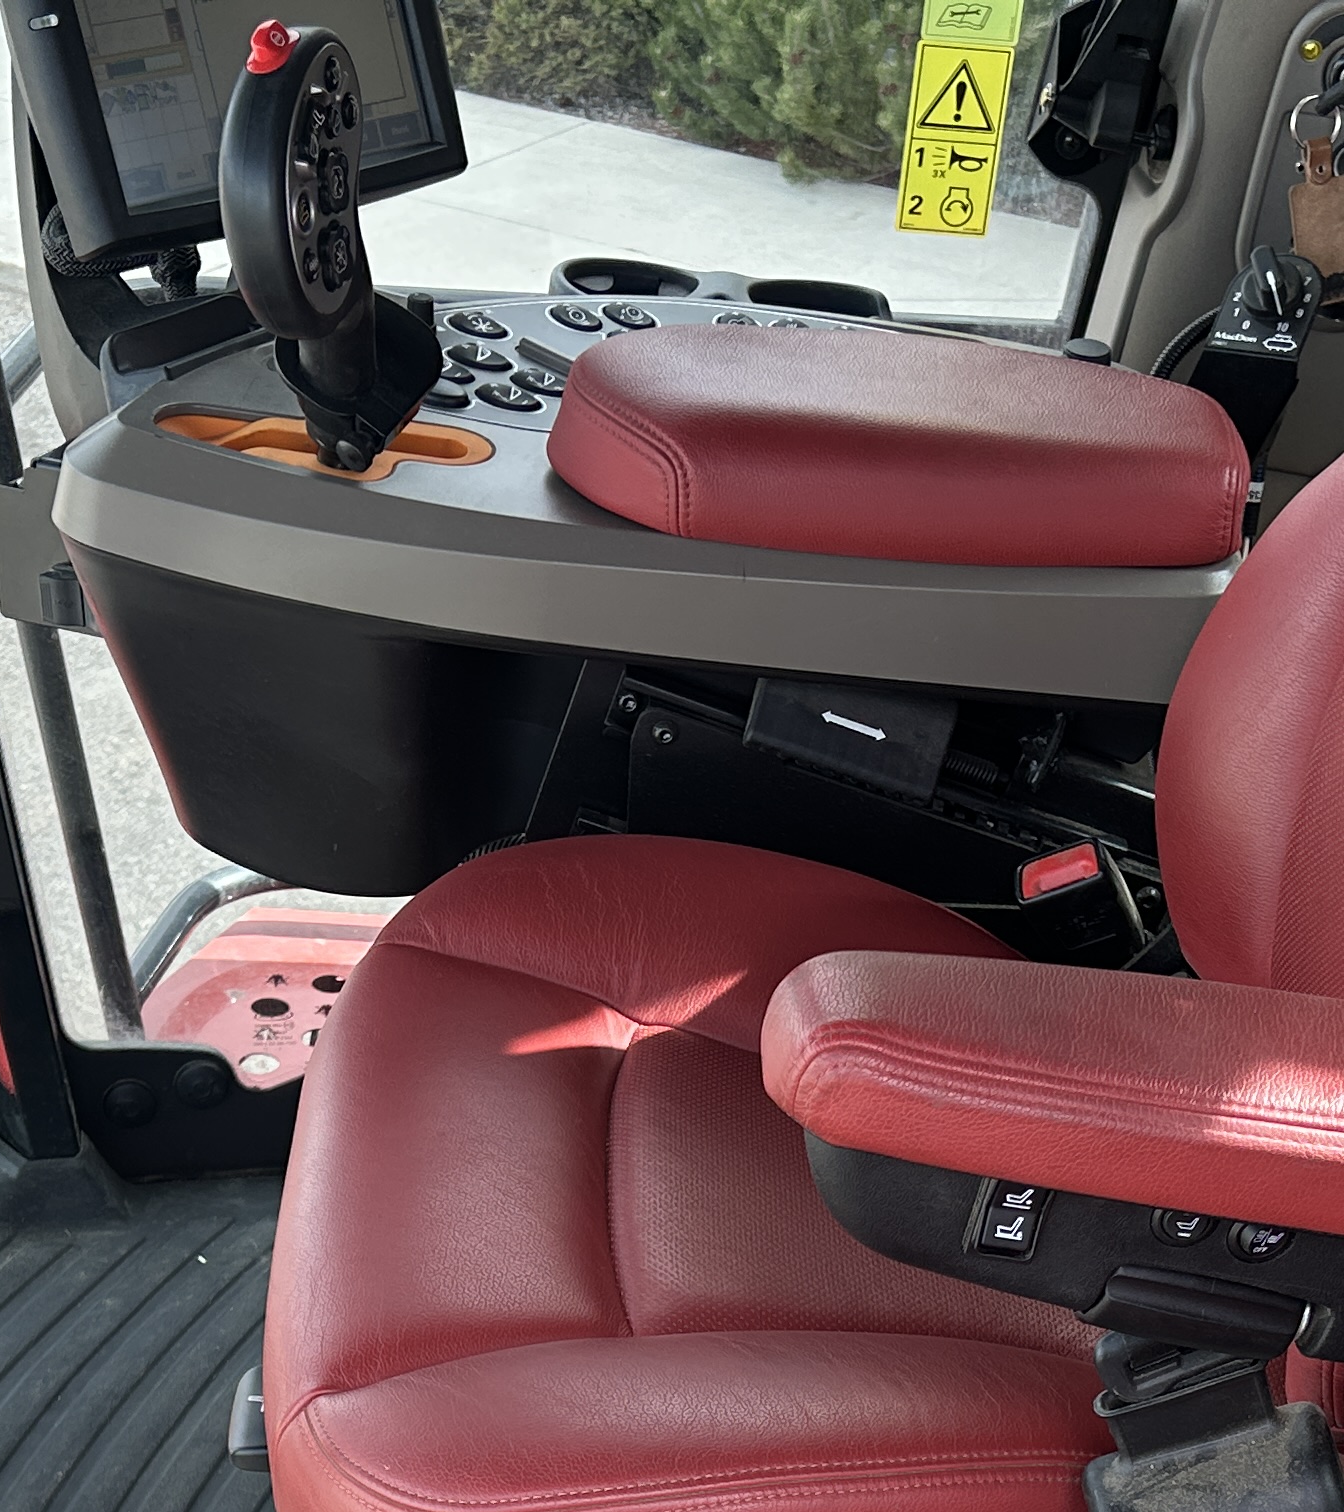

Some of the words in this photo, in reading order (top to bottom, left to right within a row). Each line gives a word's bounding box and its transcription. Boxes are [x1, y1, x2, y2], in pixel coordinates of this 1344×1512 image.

[915, 147, 925, 168] 1
[932, 170, 946, 178] 3X
[908, 195, 923, 215] 2
[1303, 276, 1312, 286] 7
[1233, 292, 1242, 302] 2
[1303, 293, 1312, 303] 8
[1233, 307, 1240, 317] 1
[1295, 308, 1304, 318] 9
[1242, 320, 1251, 330] 0
[1276, 322, 1290, 332] 10
